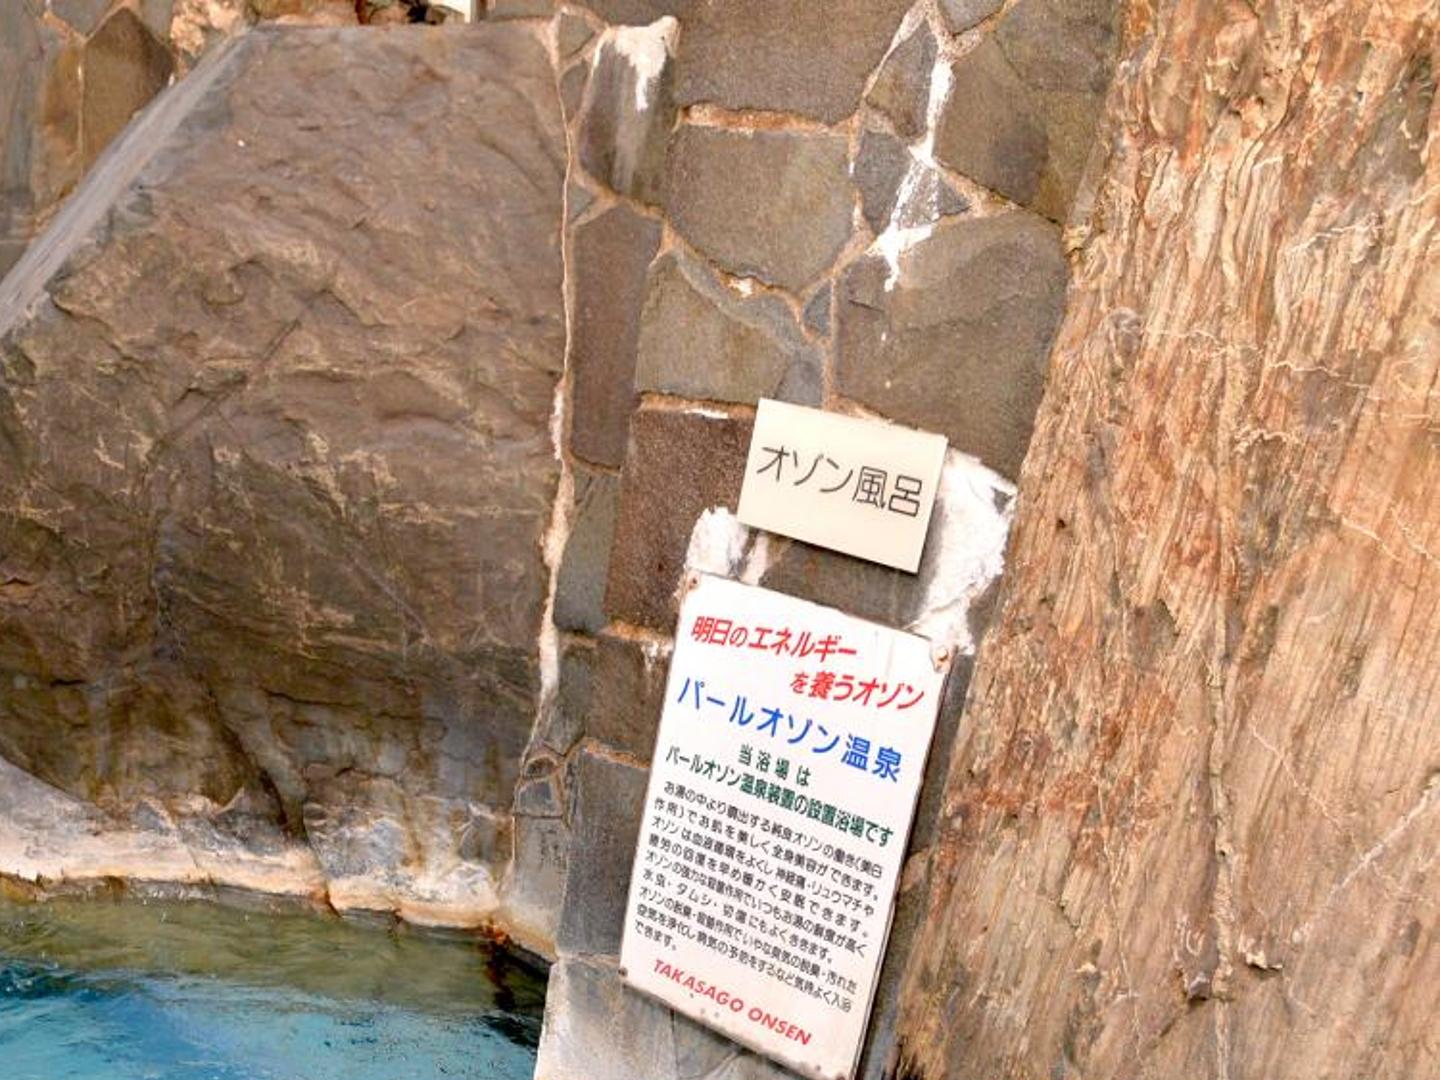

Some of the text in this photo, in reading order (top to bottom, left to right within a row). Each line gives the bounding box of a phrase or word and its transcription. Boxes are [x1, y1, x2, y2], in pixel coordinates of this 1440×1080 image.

[757, 445, 922, 517] オゾン風呂
[691, 616, 857, 663] 明日のエネルギー
[790, 671, 924, 710] を養うオゾン
[677, 677, 902, 783] パールオゾン温泉
[654, 960, 811, 1045] TAKASAGO ONSEN
